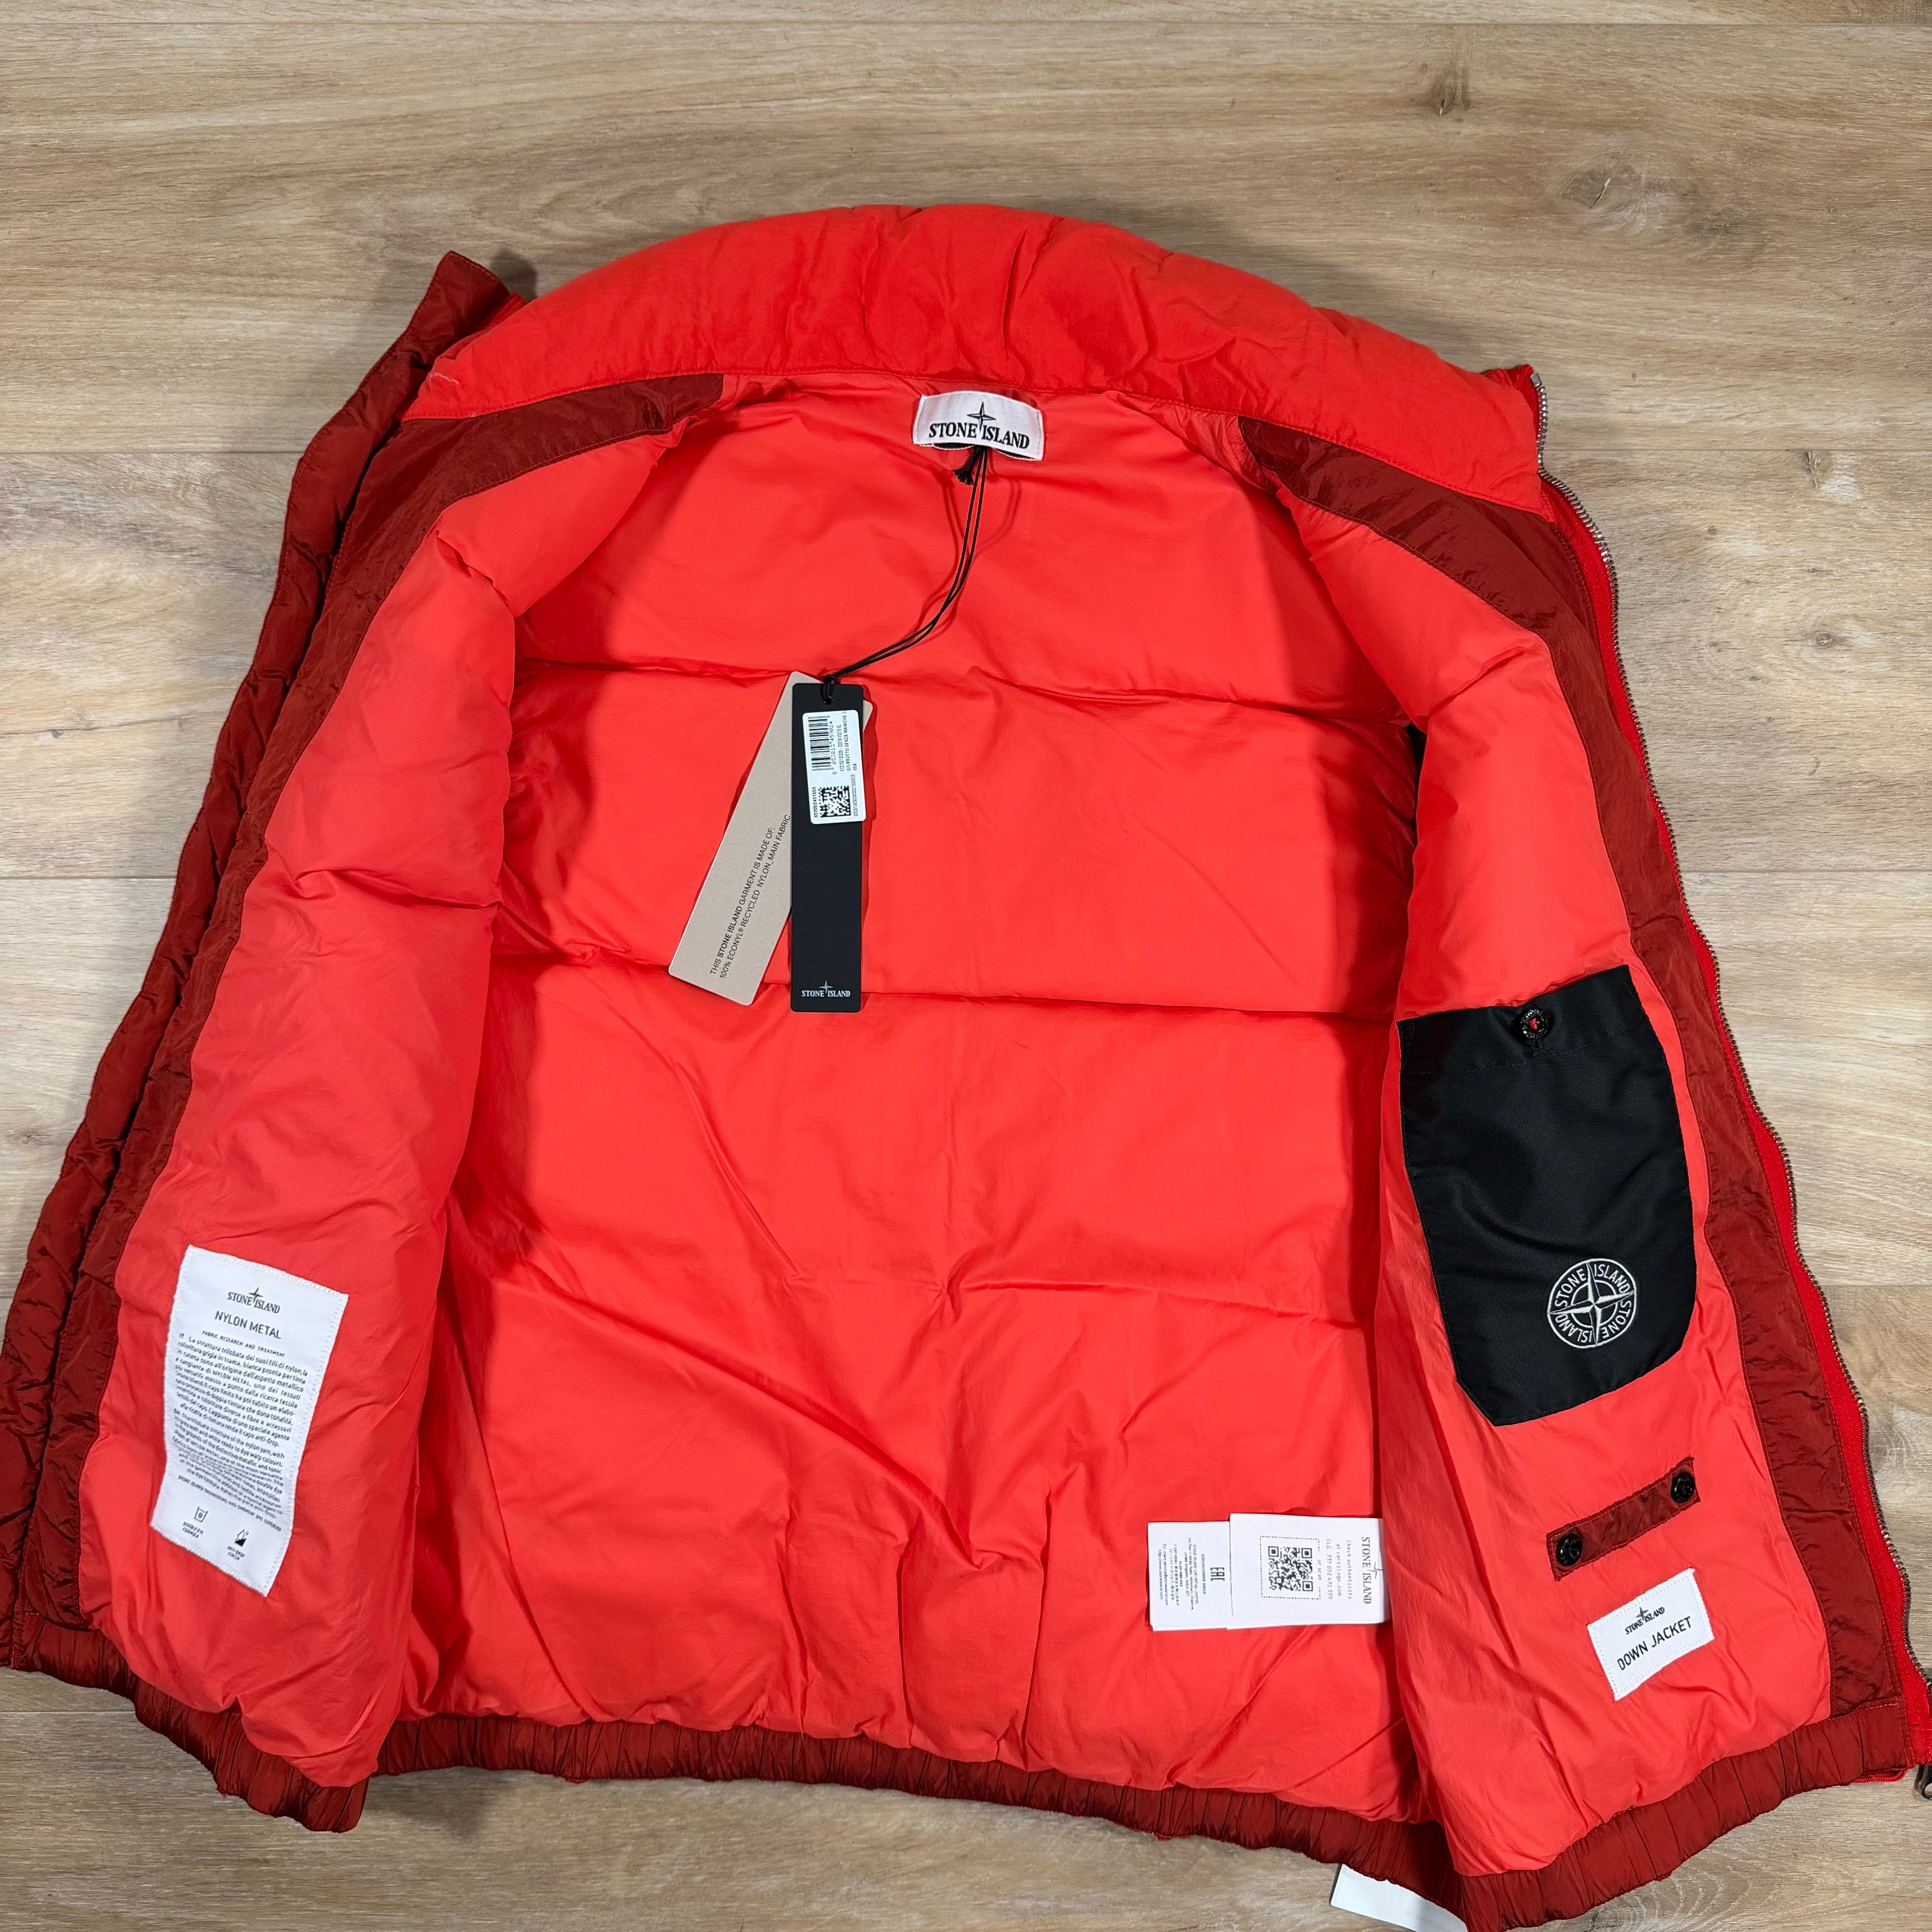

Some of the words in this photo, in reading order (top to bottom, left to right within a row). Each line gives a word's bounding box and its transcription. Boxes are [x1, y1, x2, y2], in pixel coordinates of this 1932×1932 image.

[929, 422, 977, 438] STONE
[982, 424, 1030, 449] ISLAND
[766, 827, 775, 839] OF:
[756, 840, 770, 861] MADE
[753, 861, 761, 869] IS
[720, 961, 731, 978] 100%
[741, 890, 760, 927] RECYCLED
[775, 815, 791, 841] FABRIC
[739, 869, 757, 905] GARMENT
[727, 906, 742, 933] ISLAND
[717, 933, 732, 957] STONE
[710, 958, 721, 974] THIS
[1555, 1268, 1587, 1307] STONE
[1594, 1264, 1630, 1294] ISLAND
[227, 1292, 253, 1306] STONE
[254, 1299, 280, 1313] ISLAND
[215, 1311, 248, 1328] NYLON
[250, 1322, 281, 1339] METAL
[1555, 1314, 1592, 1343] ISLAND
[1600, 1300, 1632, 1338] STONE
[260, 1393, 278, 1402] ricerca
[277, 1381, 303, 1392] metallico
[281, 1390, 301, 1400] tessuti
[1361, 1537, 1371, 1567] STONE
[1362, 1572, 1372, 1603] ISLAND
[1625, 1619, 1644, 1635] STONE
[1645, 1606, 1665, 1623] ISLAND
[1617, 1641, 1648, 1670] DOWN
[1651, 1616, 1692, 1648] JACKET
